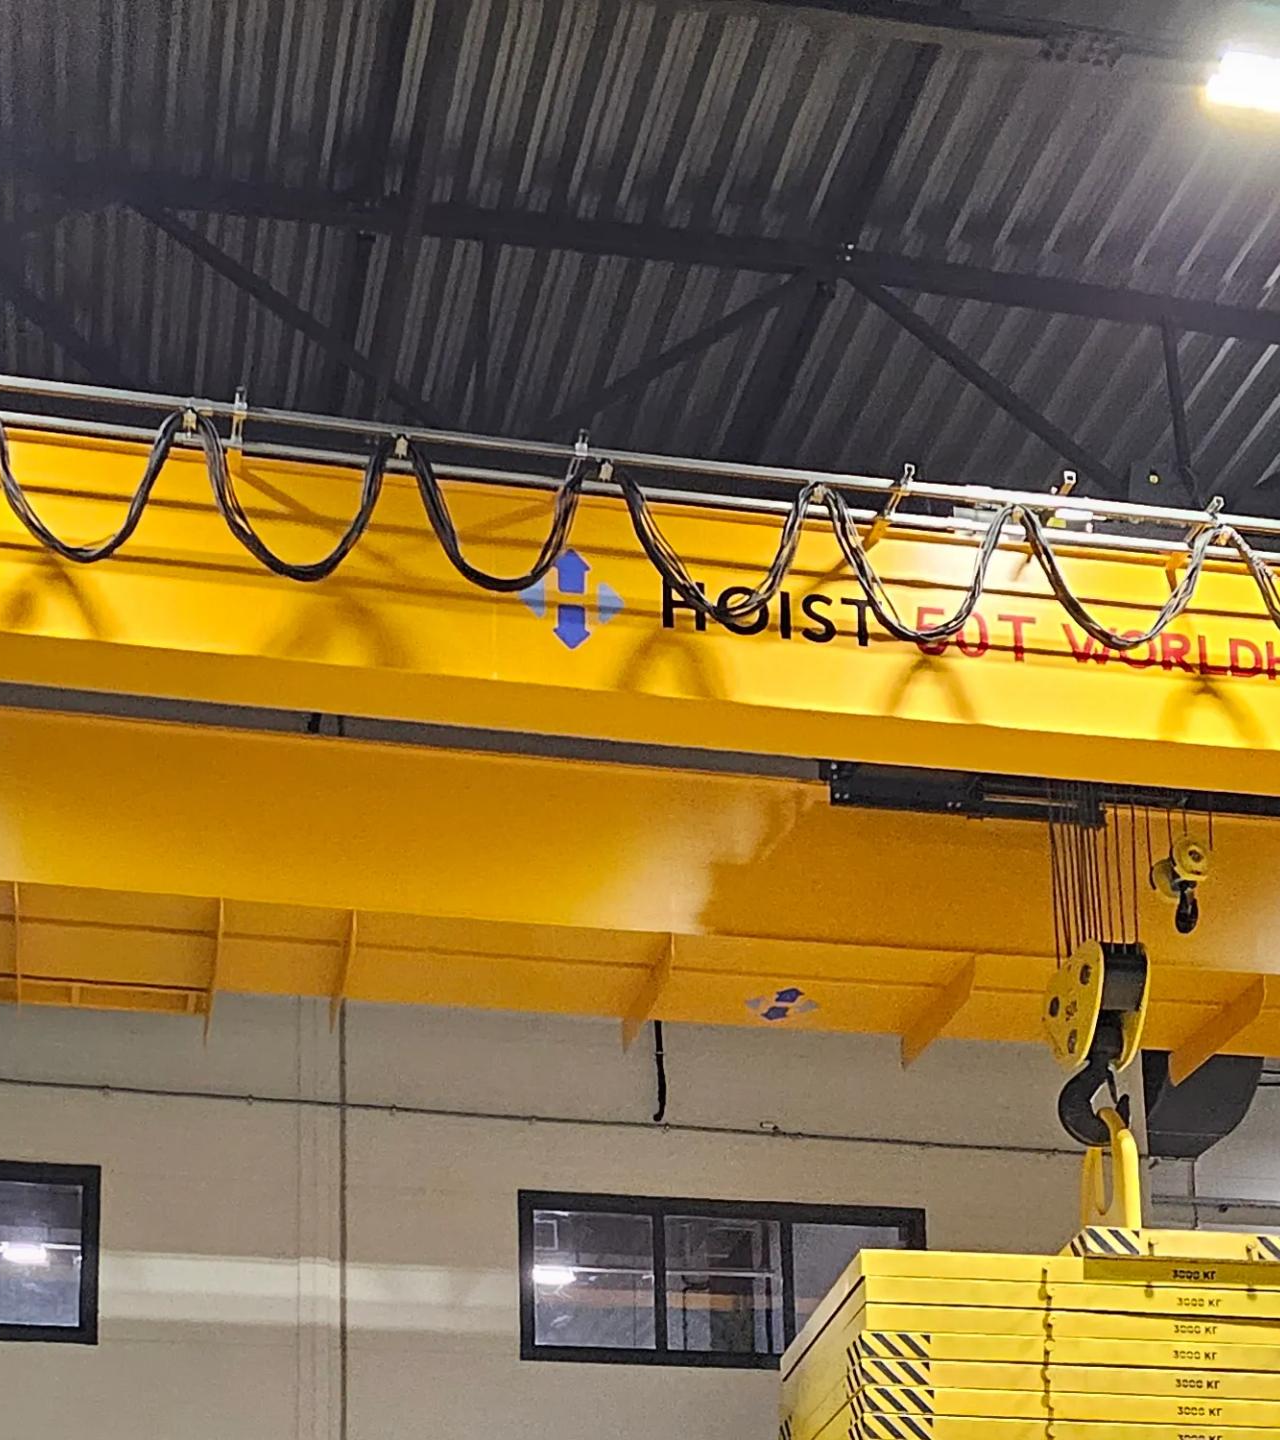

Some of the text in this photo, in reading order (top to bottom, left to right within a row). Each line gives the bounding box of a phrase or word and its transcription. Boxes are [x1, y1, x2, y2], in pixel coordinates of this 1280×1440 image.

[662, 575, 882, 647] HOIST
[1172, 1269, 1200, 1280] 3000
[1177, 1297, 1204, 1307] 3000
[1174, 1325, 1201, 1334] 3000
[1173, 1350, 1200, 1360] 3000
[1175, 1379, 1203, 1388] 3000
[1177, 1406, 1205, 1416] 3000
